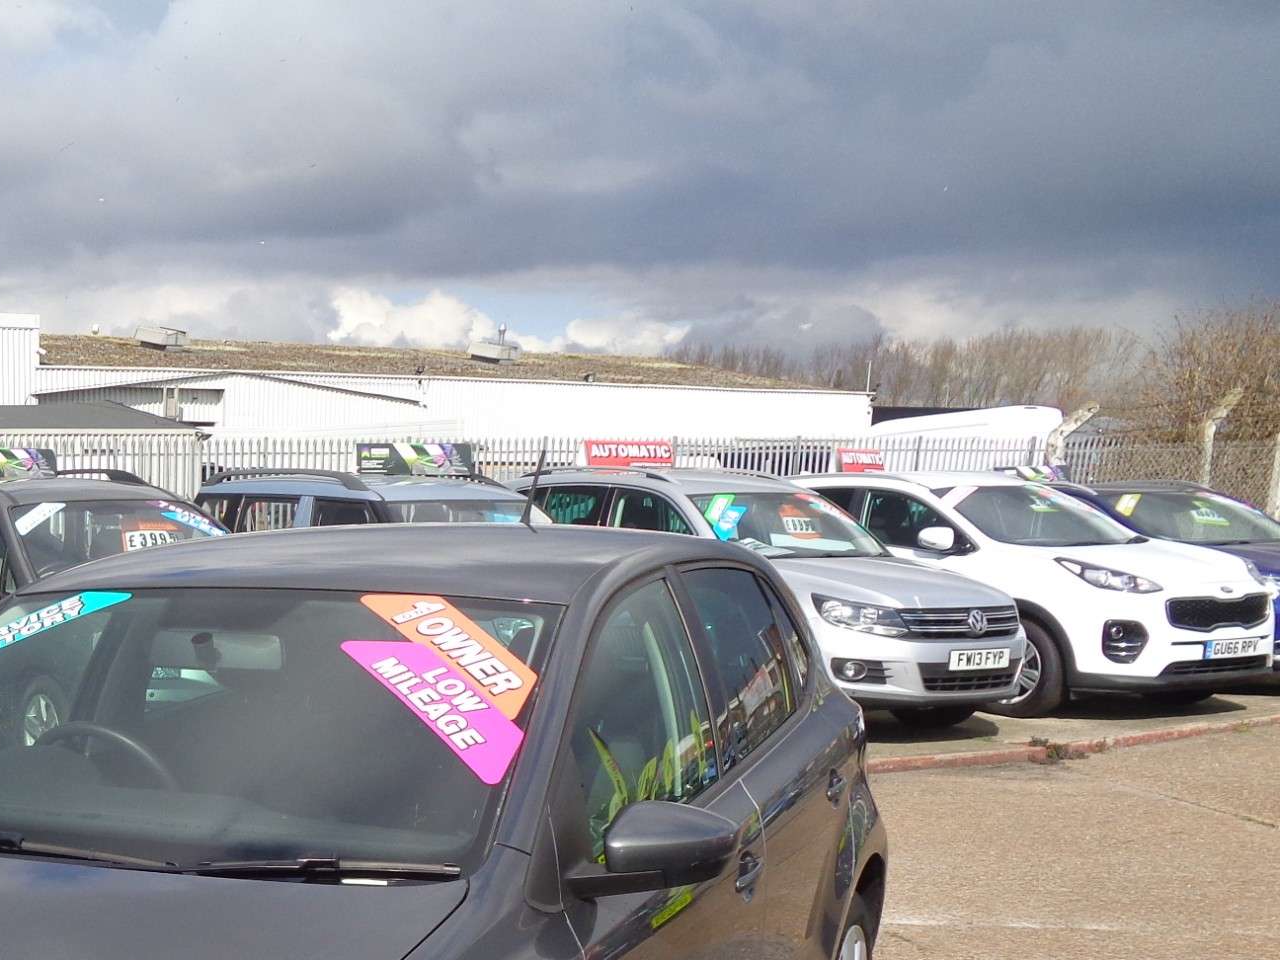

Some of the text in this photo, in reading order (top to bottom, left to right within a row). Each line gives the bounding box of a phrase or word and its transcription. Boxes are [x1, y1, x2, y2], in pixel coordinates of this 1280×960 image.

[591, 443, 672, 459] AUTOMATIC
[390, 600, 524, 697] 1 OWNER
[958, 650, 1005, 667] FW13 FYP
[1214, 641, 1240, 655] GU66
[370, 656, 487, 750] MILEAGE
[423, 666, 491, 714] LOW
